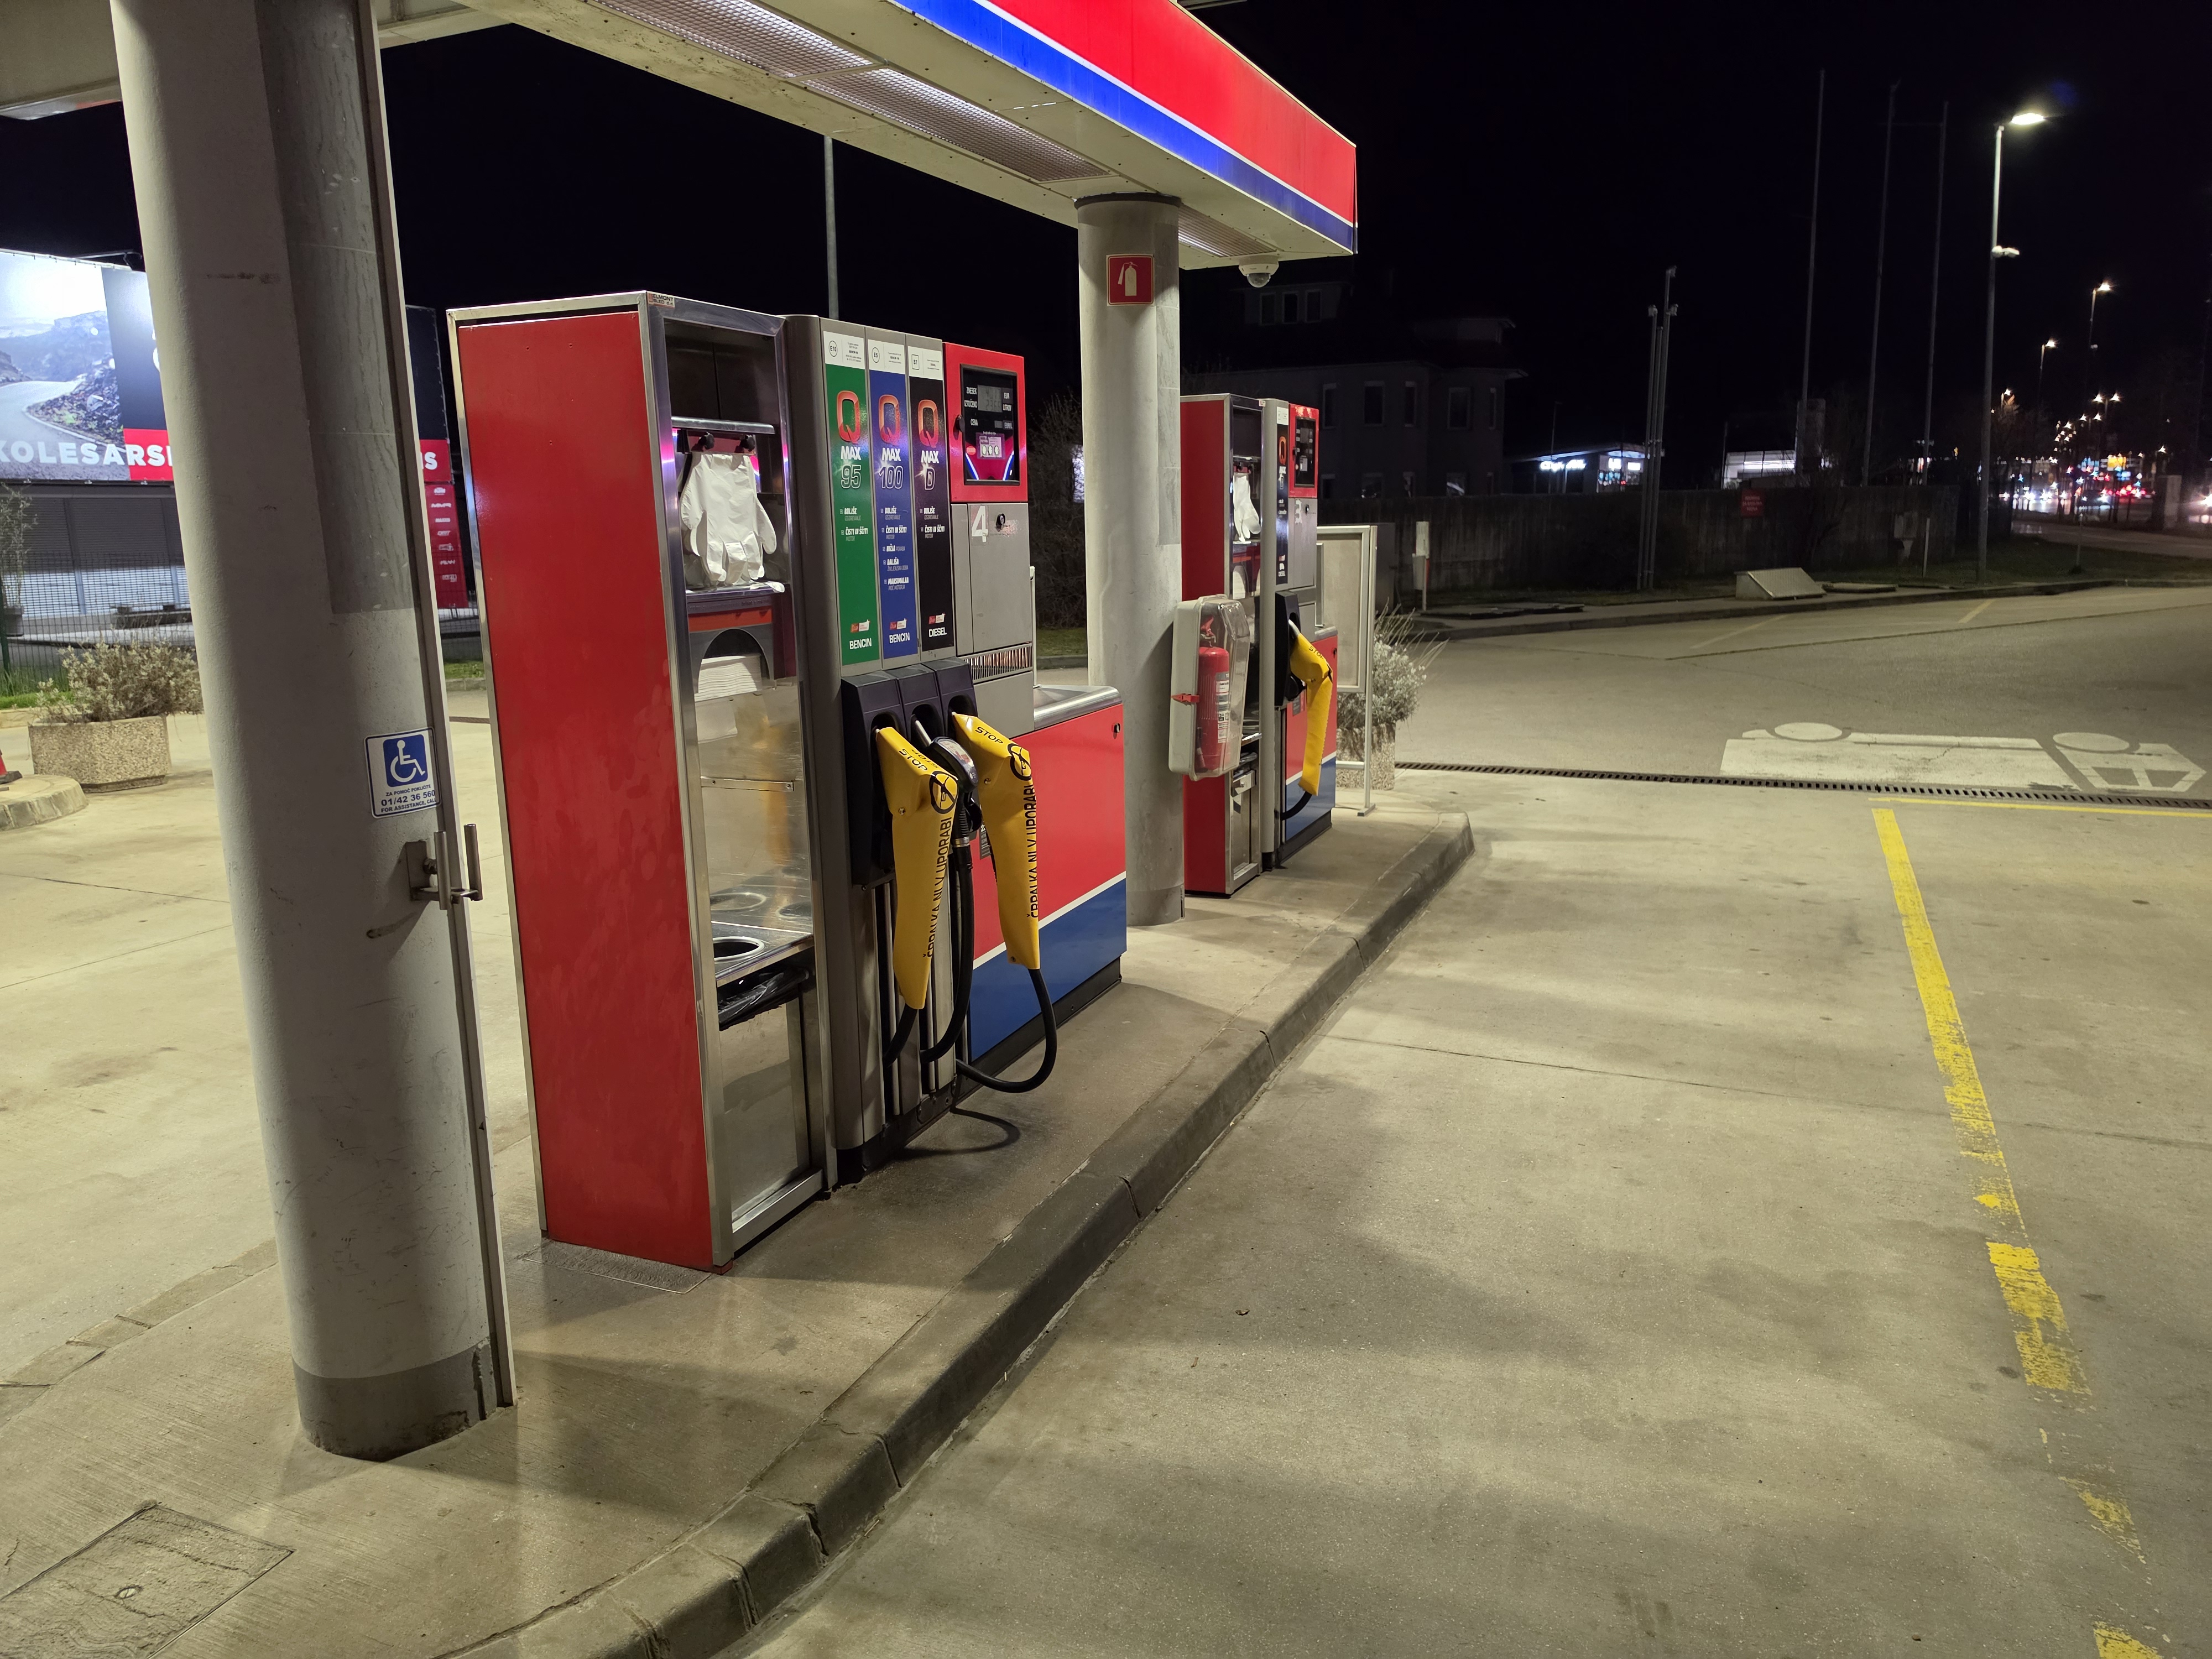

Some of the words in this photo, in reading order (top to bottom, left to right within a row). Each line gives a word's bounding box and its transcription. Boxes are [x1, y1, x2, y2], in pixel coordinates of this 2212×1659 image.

[837, 390, 861, 444] Q
[879, 394, 901, 446] Q
[918, 399, 939, 448] Q
[0, 440, 173, 466] KOLESARS
[841, 446, 861, 460] MAX
[882, 448, 901, 461] MAX
[921, 450, 939, 463] MAX
[841, 464, 862, 489] 95
[878, 466, 904, 489] 100
[925, 467, 936, 491] D
[1295, 499, 1302, 524] 3
[972, 505, 988, 542] 4
[889, 632, 910, 644] BENCIN
[928, 627, 947, 638] DIESEL
[849, 638, 872, 650] BENCIN
[975, 727, 1004, 744] STOP
[899, 748, 928, 770] STOP
[381, 796, 408, 806] 01/42
[411, 793, 421, 801] 36
[423, 790, 435, 799] 560
[394, 800, 426, 811] ASSISTANCE,
[936, 817, 952, 873] UPORABI
[1027, 839, 1036, 848] V
[1027, 851, 1037, 863] NI
[935, 877, 945, 886] V
